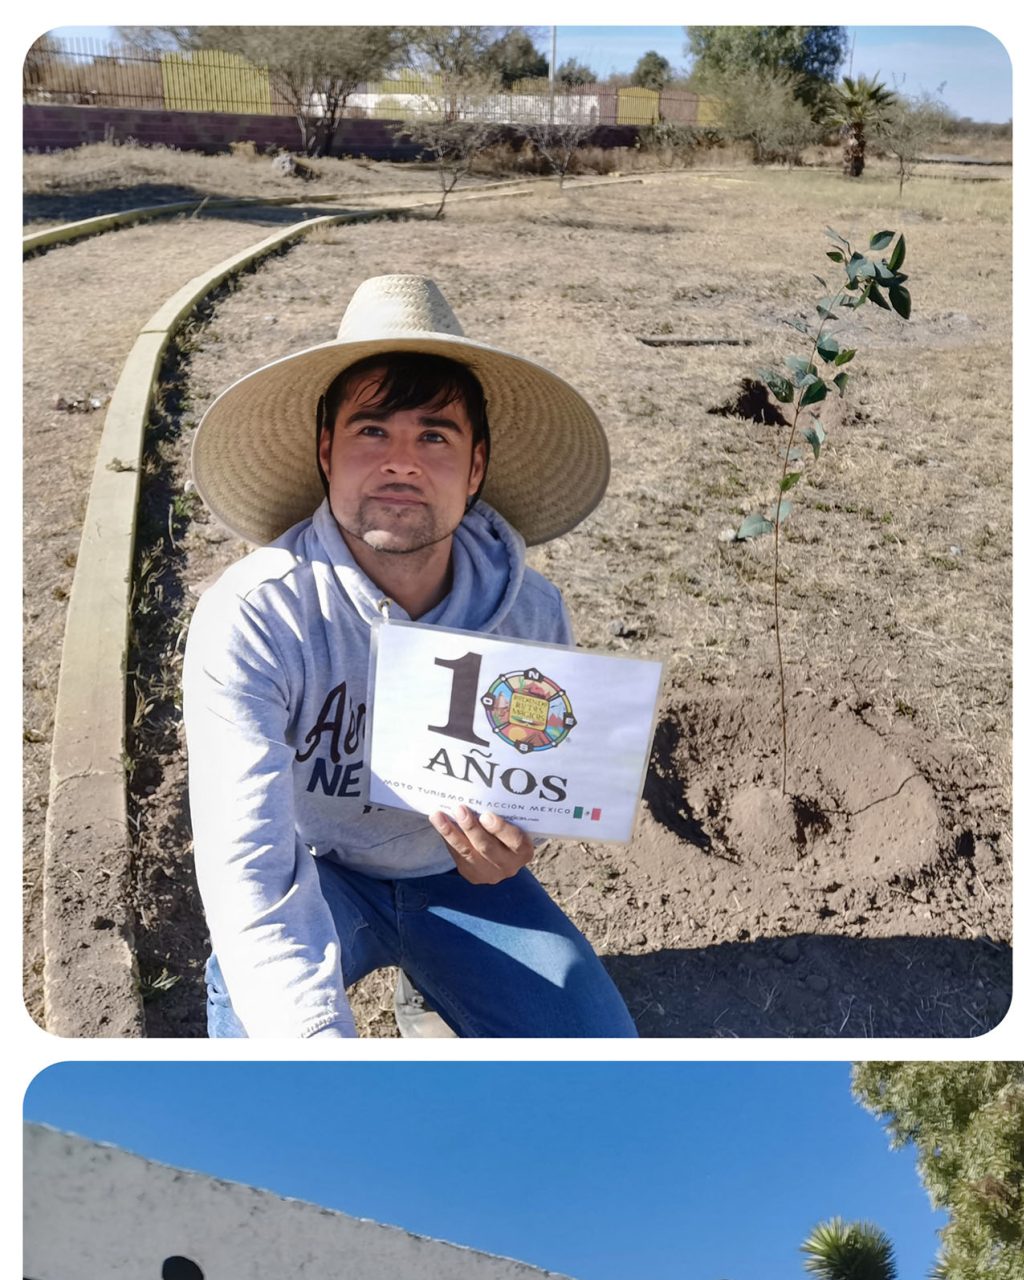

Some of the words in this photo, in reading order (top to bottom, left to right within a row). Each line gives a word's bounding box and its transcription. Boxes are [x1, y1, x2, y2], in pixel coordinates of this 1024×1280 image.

[306, 757, 363, 797] NE
[383, 779, 413, 790] MOTO
[417, 786, 464, 802] TURISMO
[468, 798, 483, 806] EN
[423, 748, 568, 802] AÑOS
